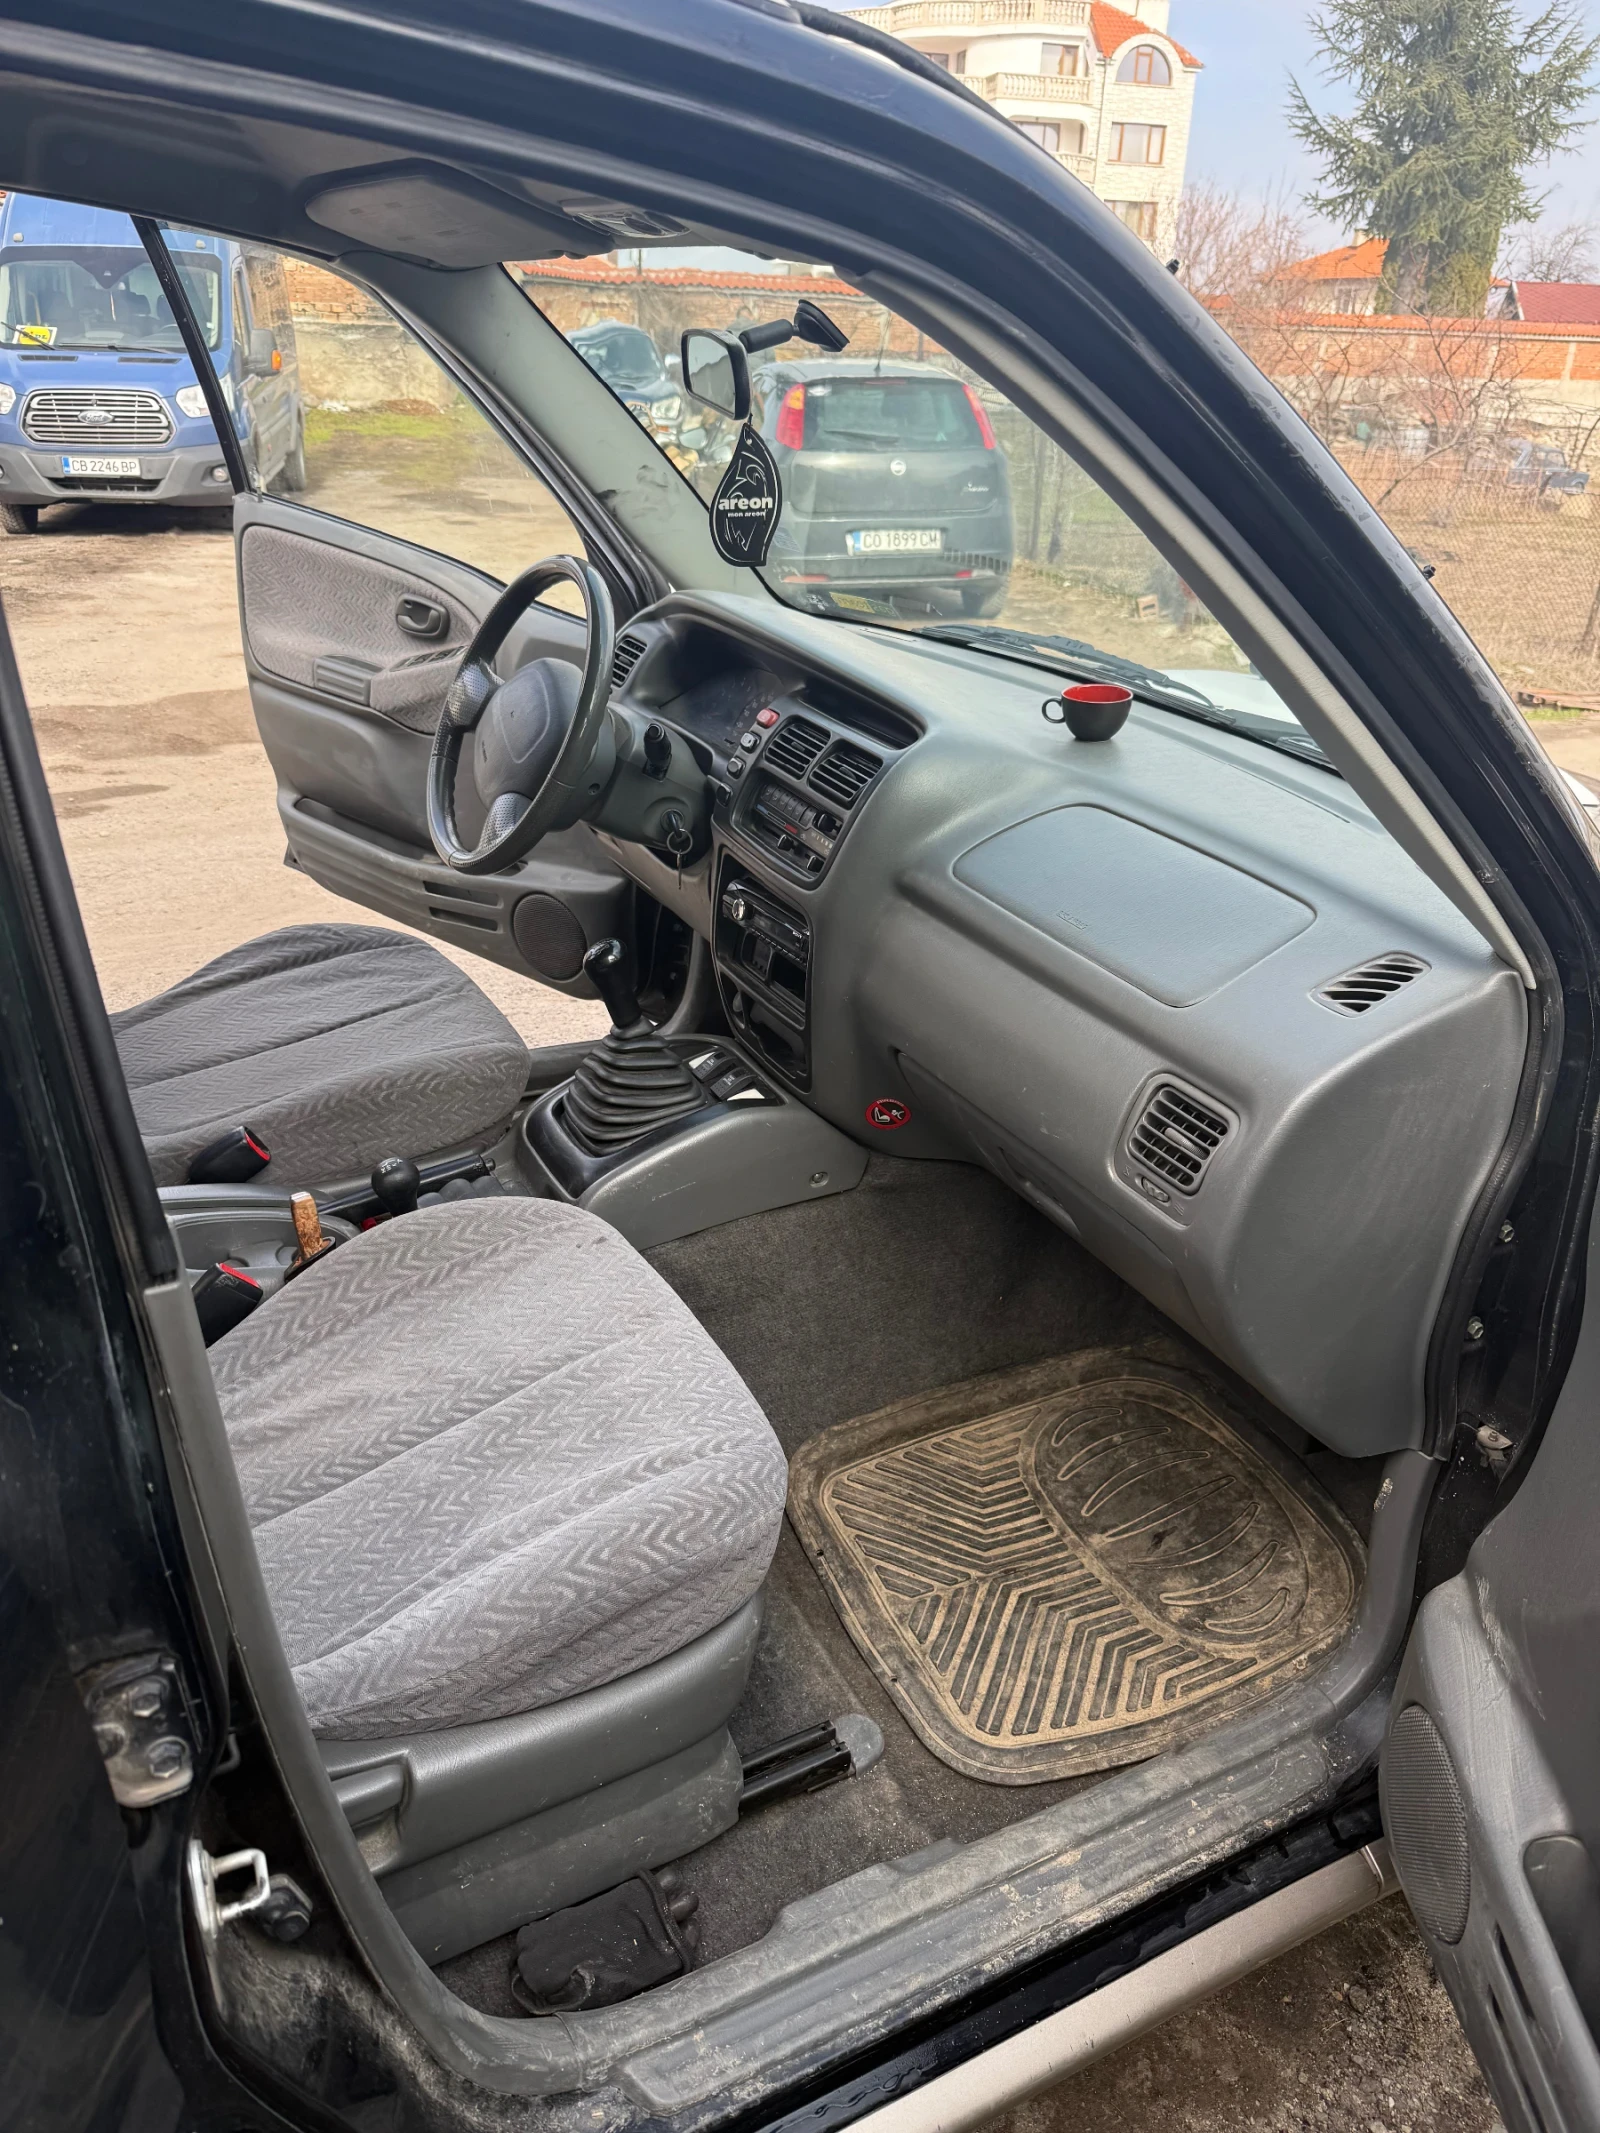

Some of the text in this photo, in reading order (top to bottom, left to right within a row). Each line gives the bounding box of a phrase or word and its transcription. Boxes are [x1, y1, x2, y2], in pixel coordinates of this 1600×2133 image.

[72, 460, 137, 473] CB 2246 BP
[718, 496, 773, 511] areon
[886, 532, 917, 548] 1899
